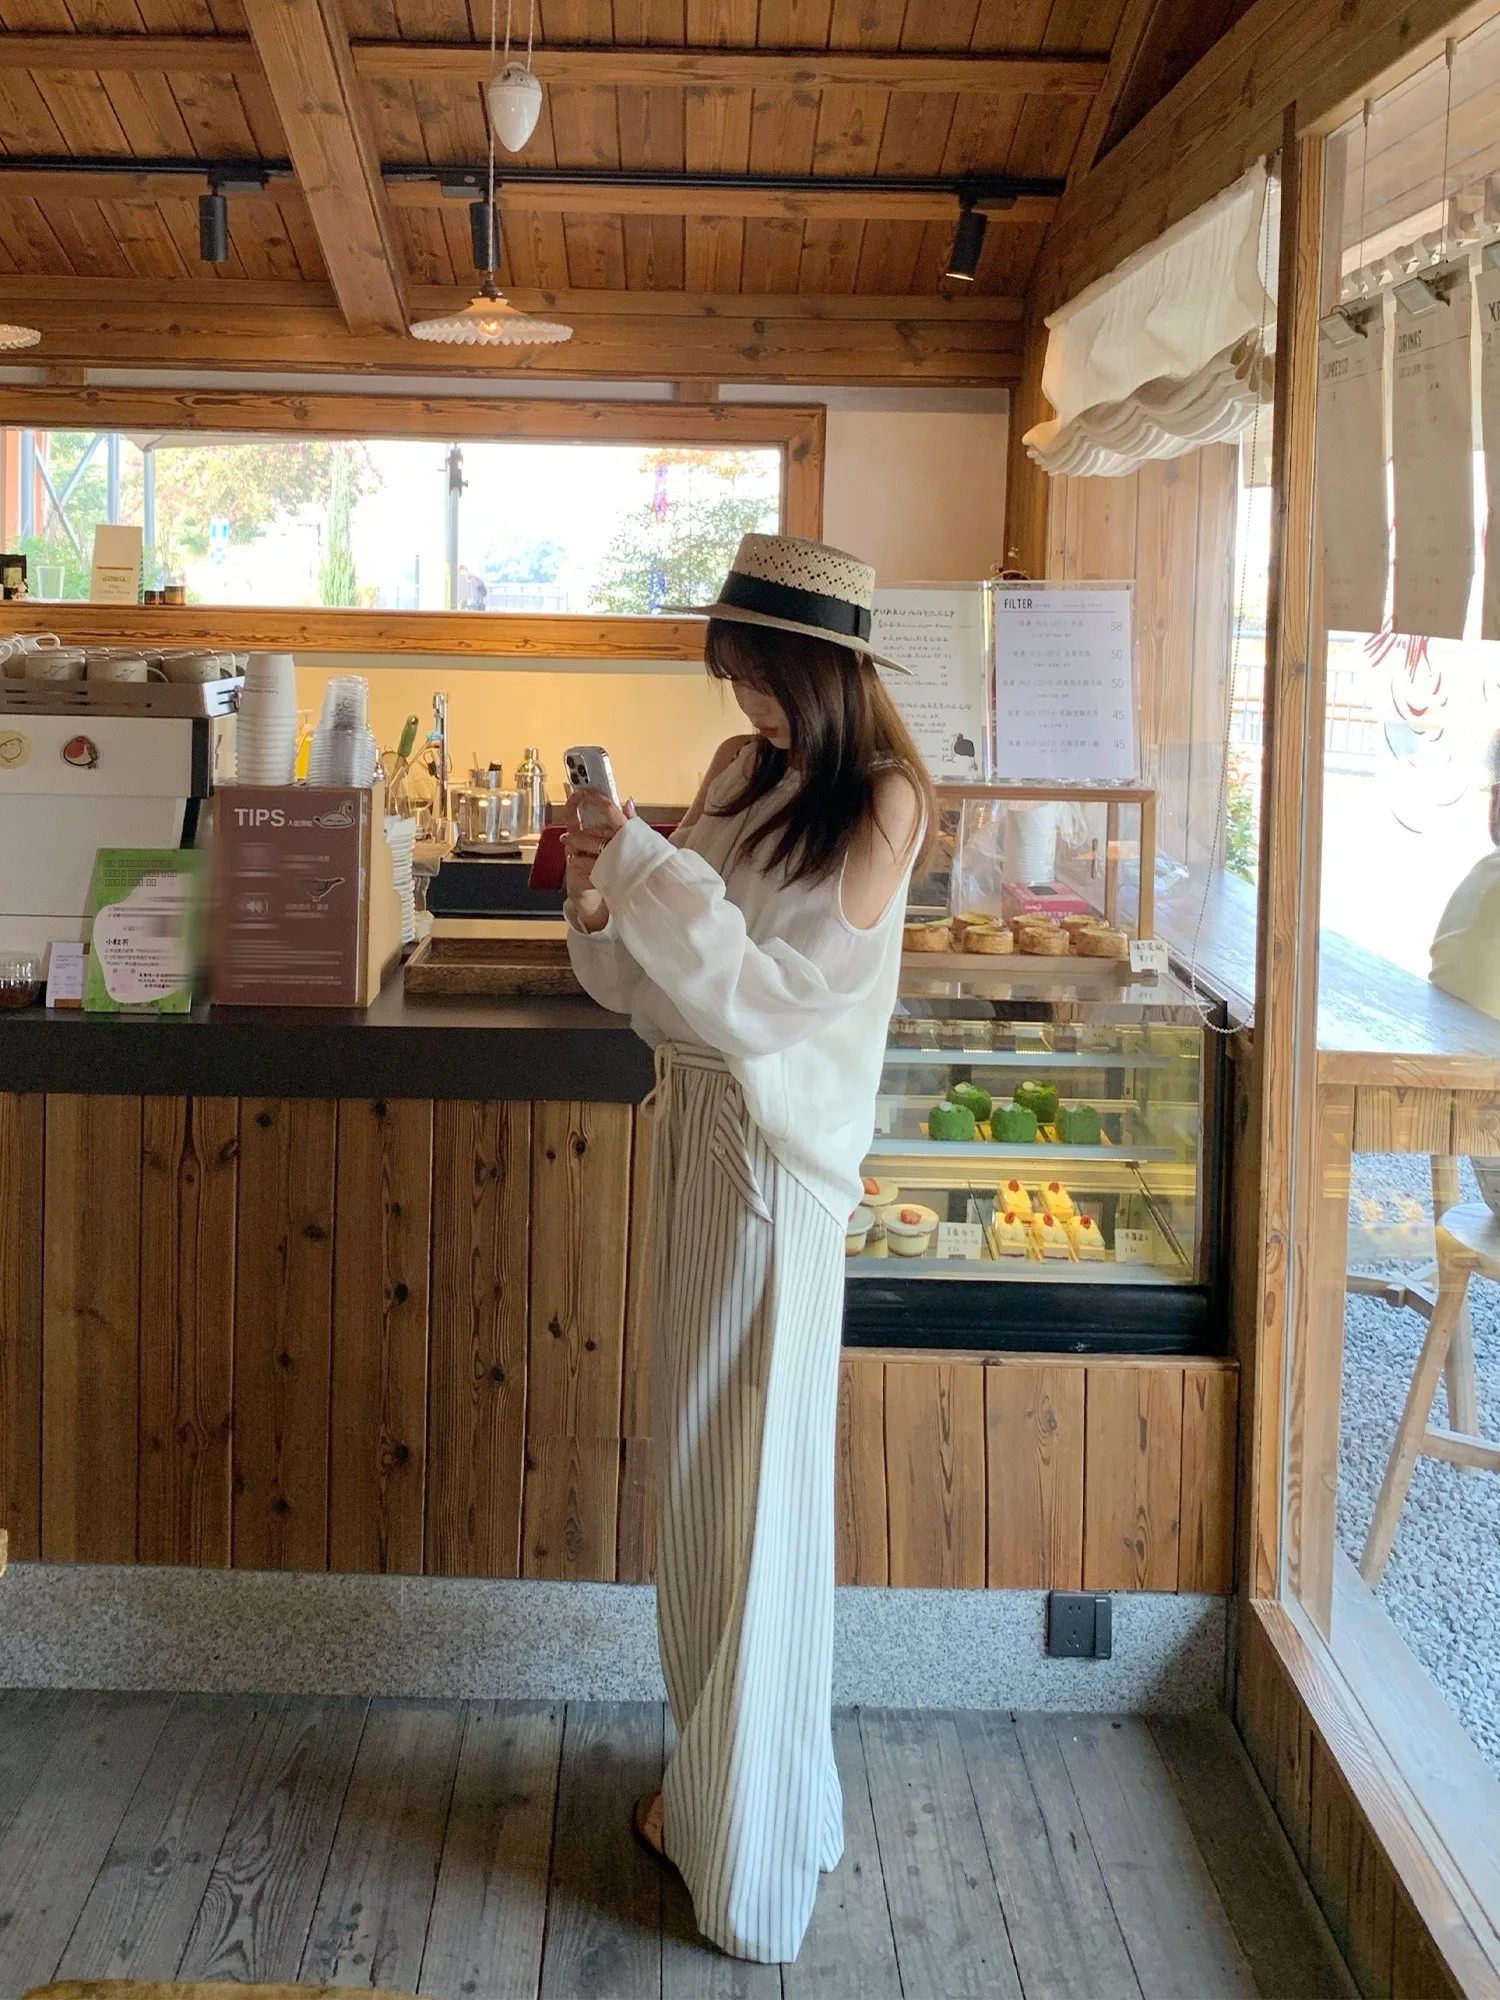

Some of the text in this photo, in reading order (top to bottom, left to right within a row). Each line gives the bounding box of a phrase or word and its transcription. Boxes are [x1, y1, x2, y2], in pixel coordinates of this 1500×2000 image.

[1398, 329, 1422, 353] DRINKS
[1004, 598, 1033, 609] FILTER
[1110, 621, 1123, 632] 58
[1111, 649, 1123, 660] 50
[1111, 678, 1124, 689] 50
[1112, 710, 1125, 720] 45
[1113, 739, 1125, 749] 45
[234, 808, 286, 827] TIPS
[105, 938, 129, 946] 小红书
